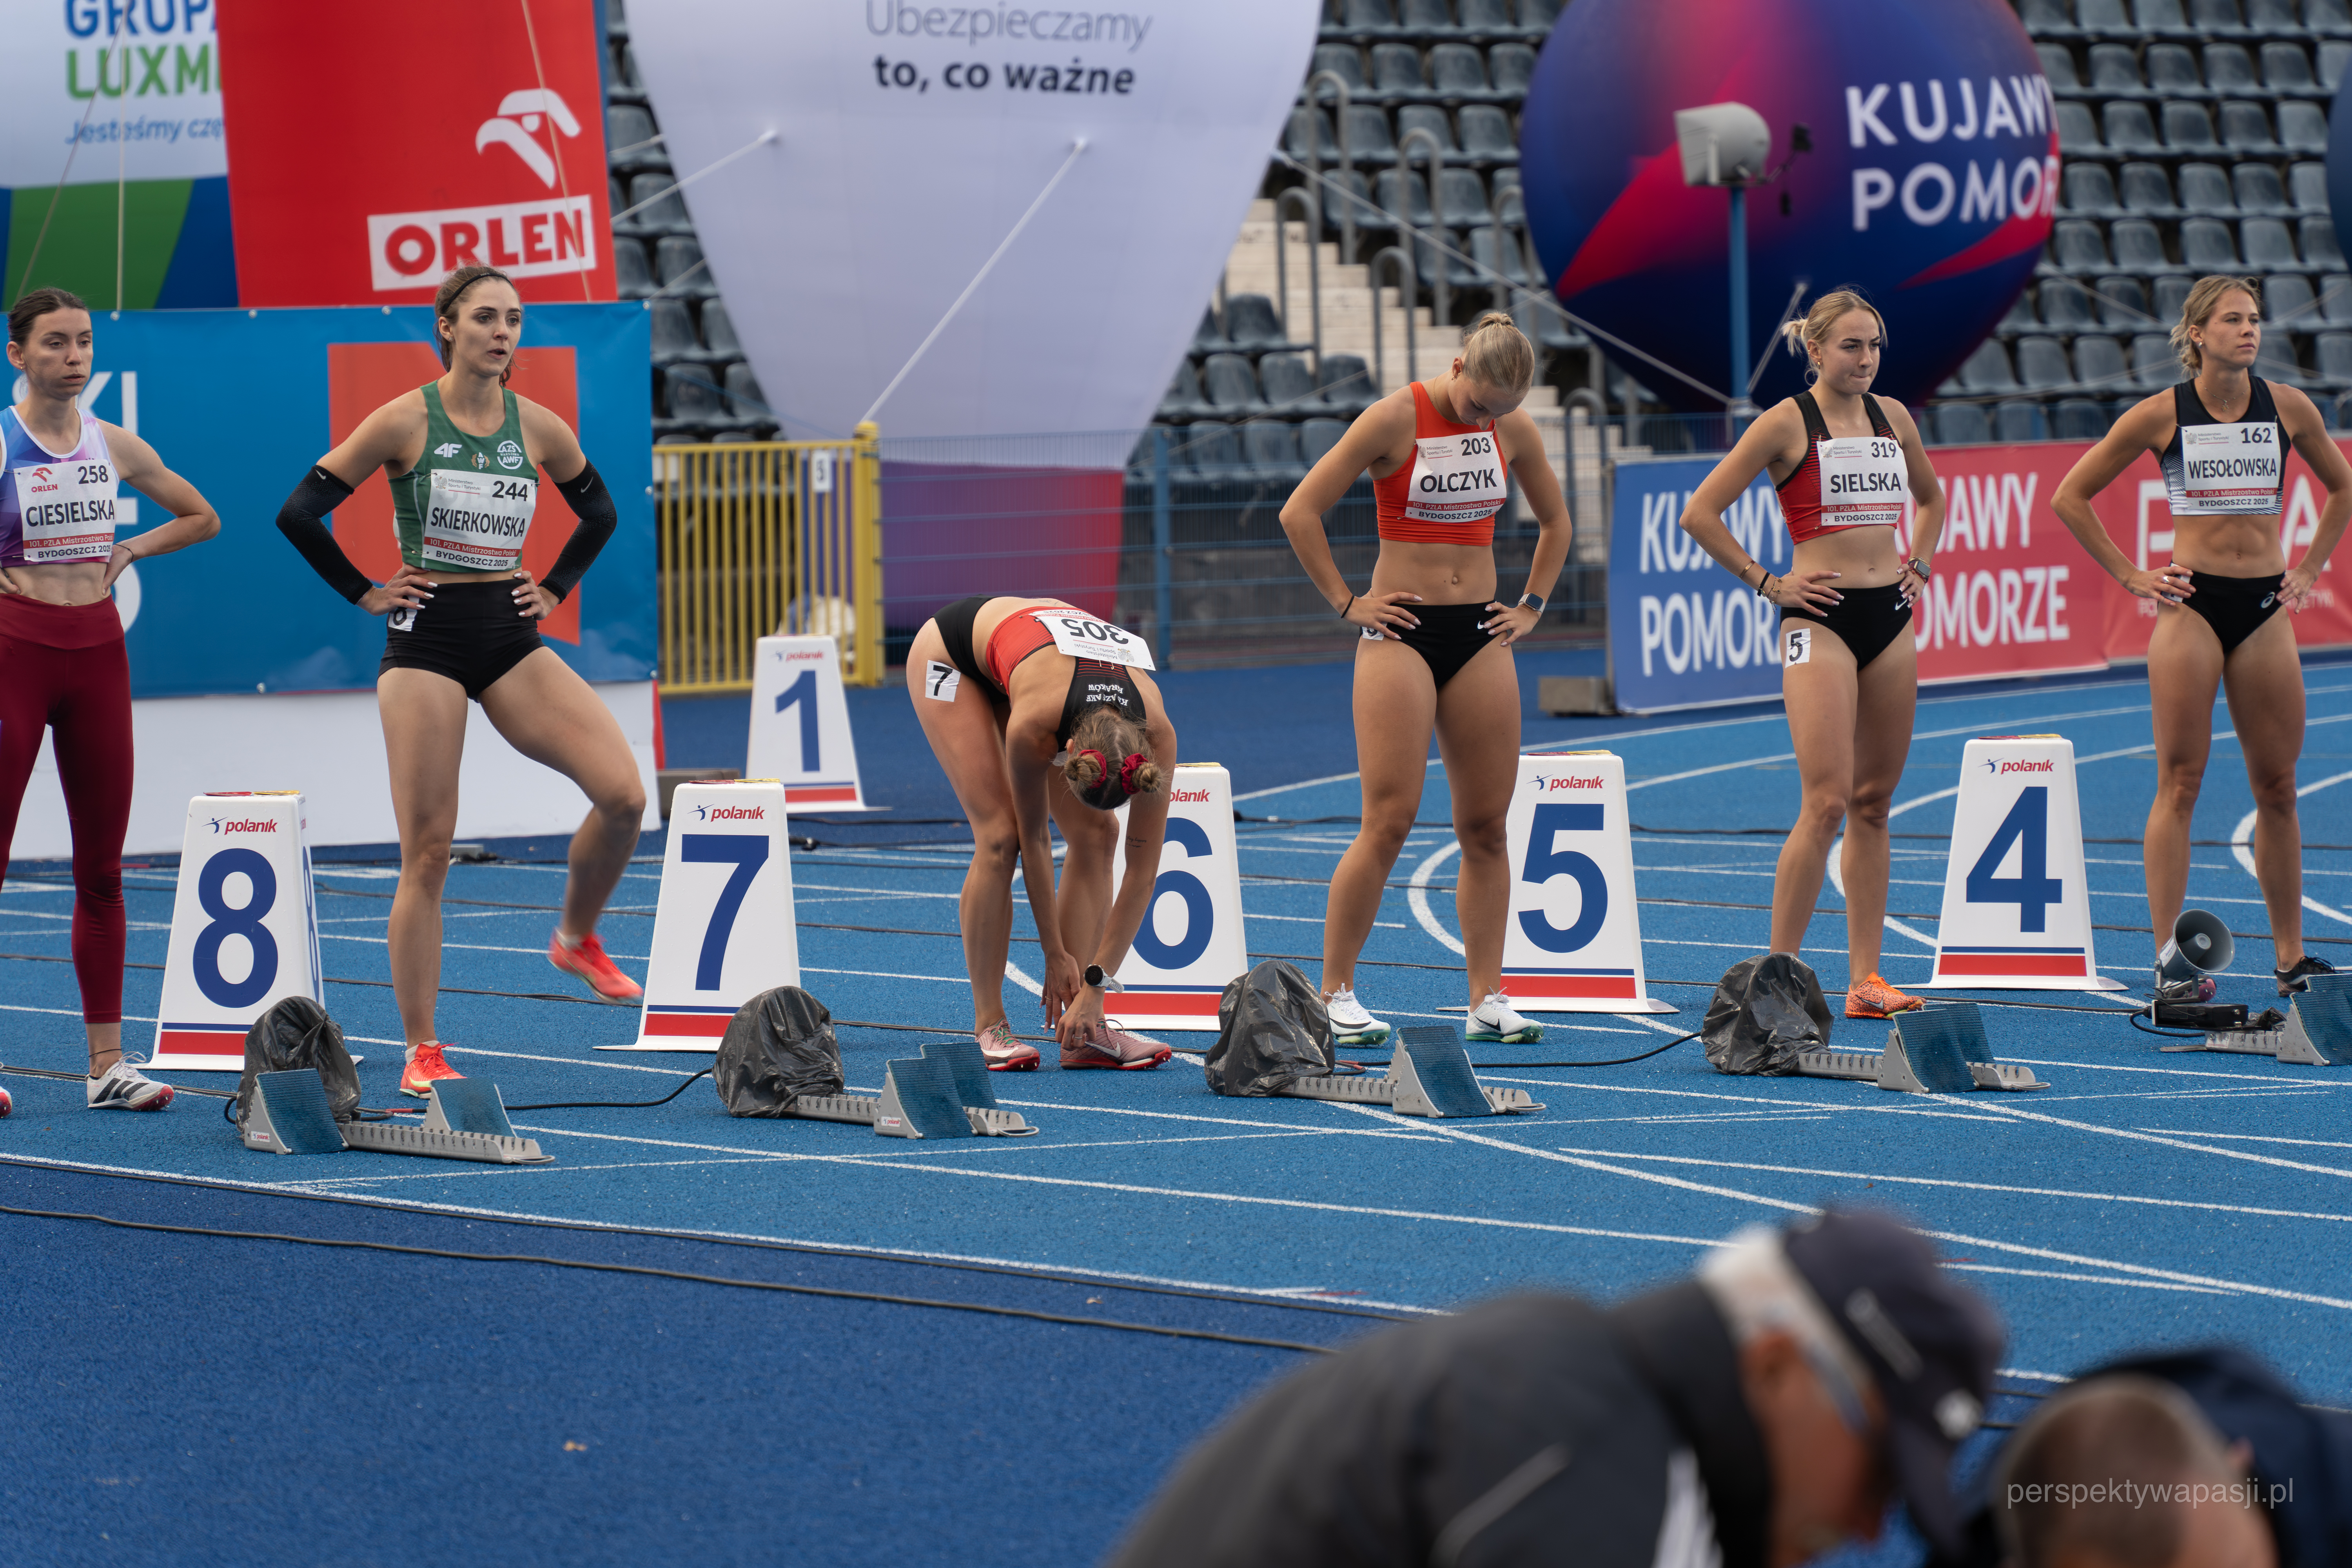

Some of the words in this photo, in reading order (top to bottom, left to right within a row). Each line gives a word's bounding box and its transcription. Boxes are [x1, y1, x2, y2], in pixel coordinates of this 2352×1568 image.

[65, 0, 217, 39] GRUP
[866, 0, 1152, 54] Ubezpieczamy
[66, 41, 222, 100] LUXM
[873, 54, 929, 94] to,
[943, 61, 990, 89] co
[1003, 57, 1135, 94] ważne
[385, 209, 586, 276] ORLEN
[2240, 428, 2272, 443] 162
[434, 443, 462, 457] 4F
[1461, 437, 1491, 456] 203
[1871, 442, 1896, 457] 319
[78, 465, 108, 484] 258
[2188, 458, 2277, 479] WESOŁOWSKA
[31, 484, 58, 492] ORLEN
[1420, 468, 1497, 493] OLCZYK
[1830, 473, 1902, 493] SIELSKA
[492, 481, 528, 501] 244
[26, 499, 114, 527] CIESIELSKA
[430, 507, 525, 537] SKIERKOWSKA
[1419, 511, 1472, 519] BYDGOSZCZ
[1474, 509, 1492, 517] 2025
[1835, 514, 1884, 522] BYDGOSZCZ
[1640, 486, 1785, 573] KUWY
[63, 536, 103, 544] Mistrzostwa
[443, 542, 460, 550] PZLA
[462, 546, 502, 555] Mistrzostwa
[38, 546, 96, 558] BYDGOSZCZ
[436, 550, 493, 566] BYDGOSZCZ
[1915, 565, 2070, 652] OMORZE
[1061, 619, 1129, 644] 305
[1640, 587, 1781, 677] POMOR
[786, 650, 824, 662] polanik
[1086, 650, 1118, 659] Ministerstwo
[1789, 632, 1803, 662] 5
[933, 665, 953, 696] 7
[1088, 684, 1123, 694] KRAKÓW
[775, 670, 820, 772] 1
[2001, 759, 2054, 775] polanik
[1550, 775, 1605, 792] polanik
[1170, 789, 1210, 802] olanik
[710, 805, 765, 822] polanik
[224, 818, 278, 835] polanik
[1966, 786, 2062, 933] 4
[1518, 804, 1608, 953] 5
[1132, 817, 1214, 969] 6
[681, 834, 769, 991] 7
[193, 848, 278, 1008] 8
